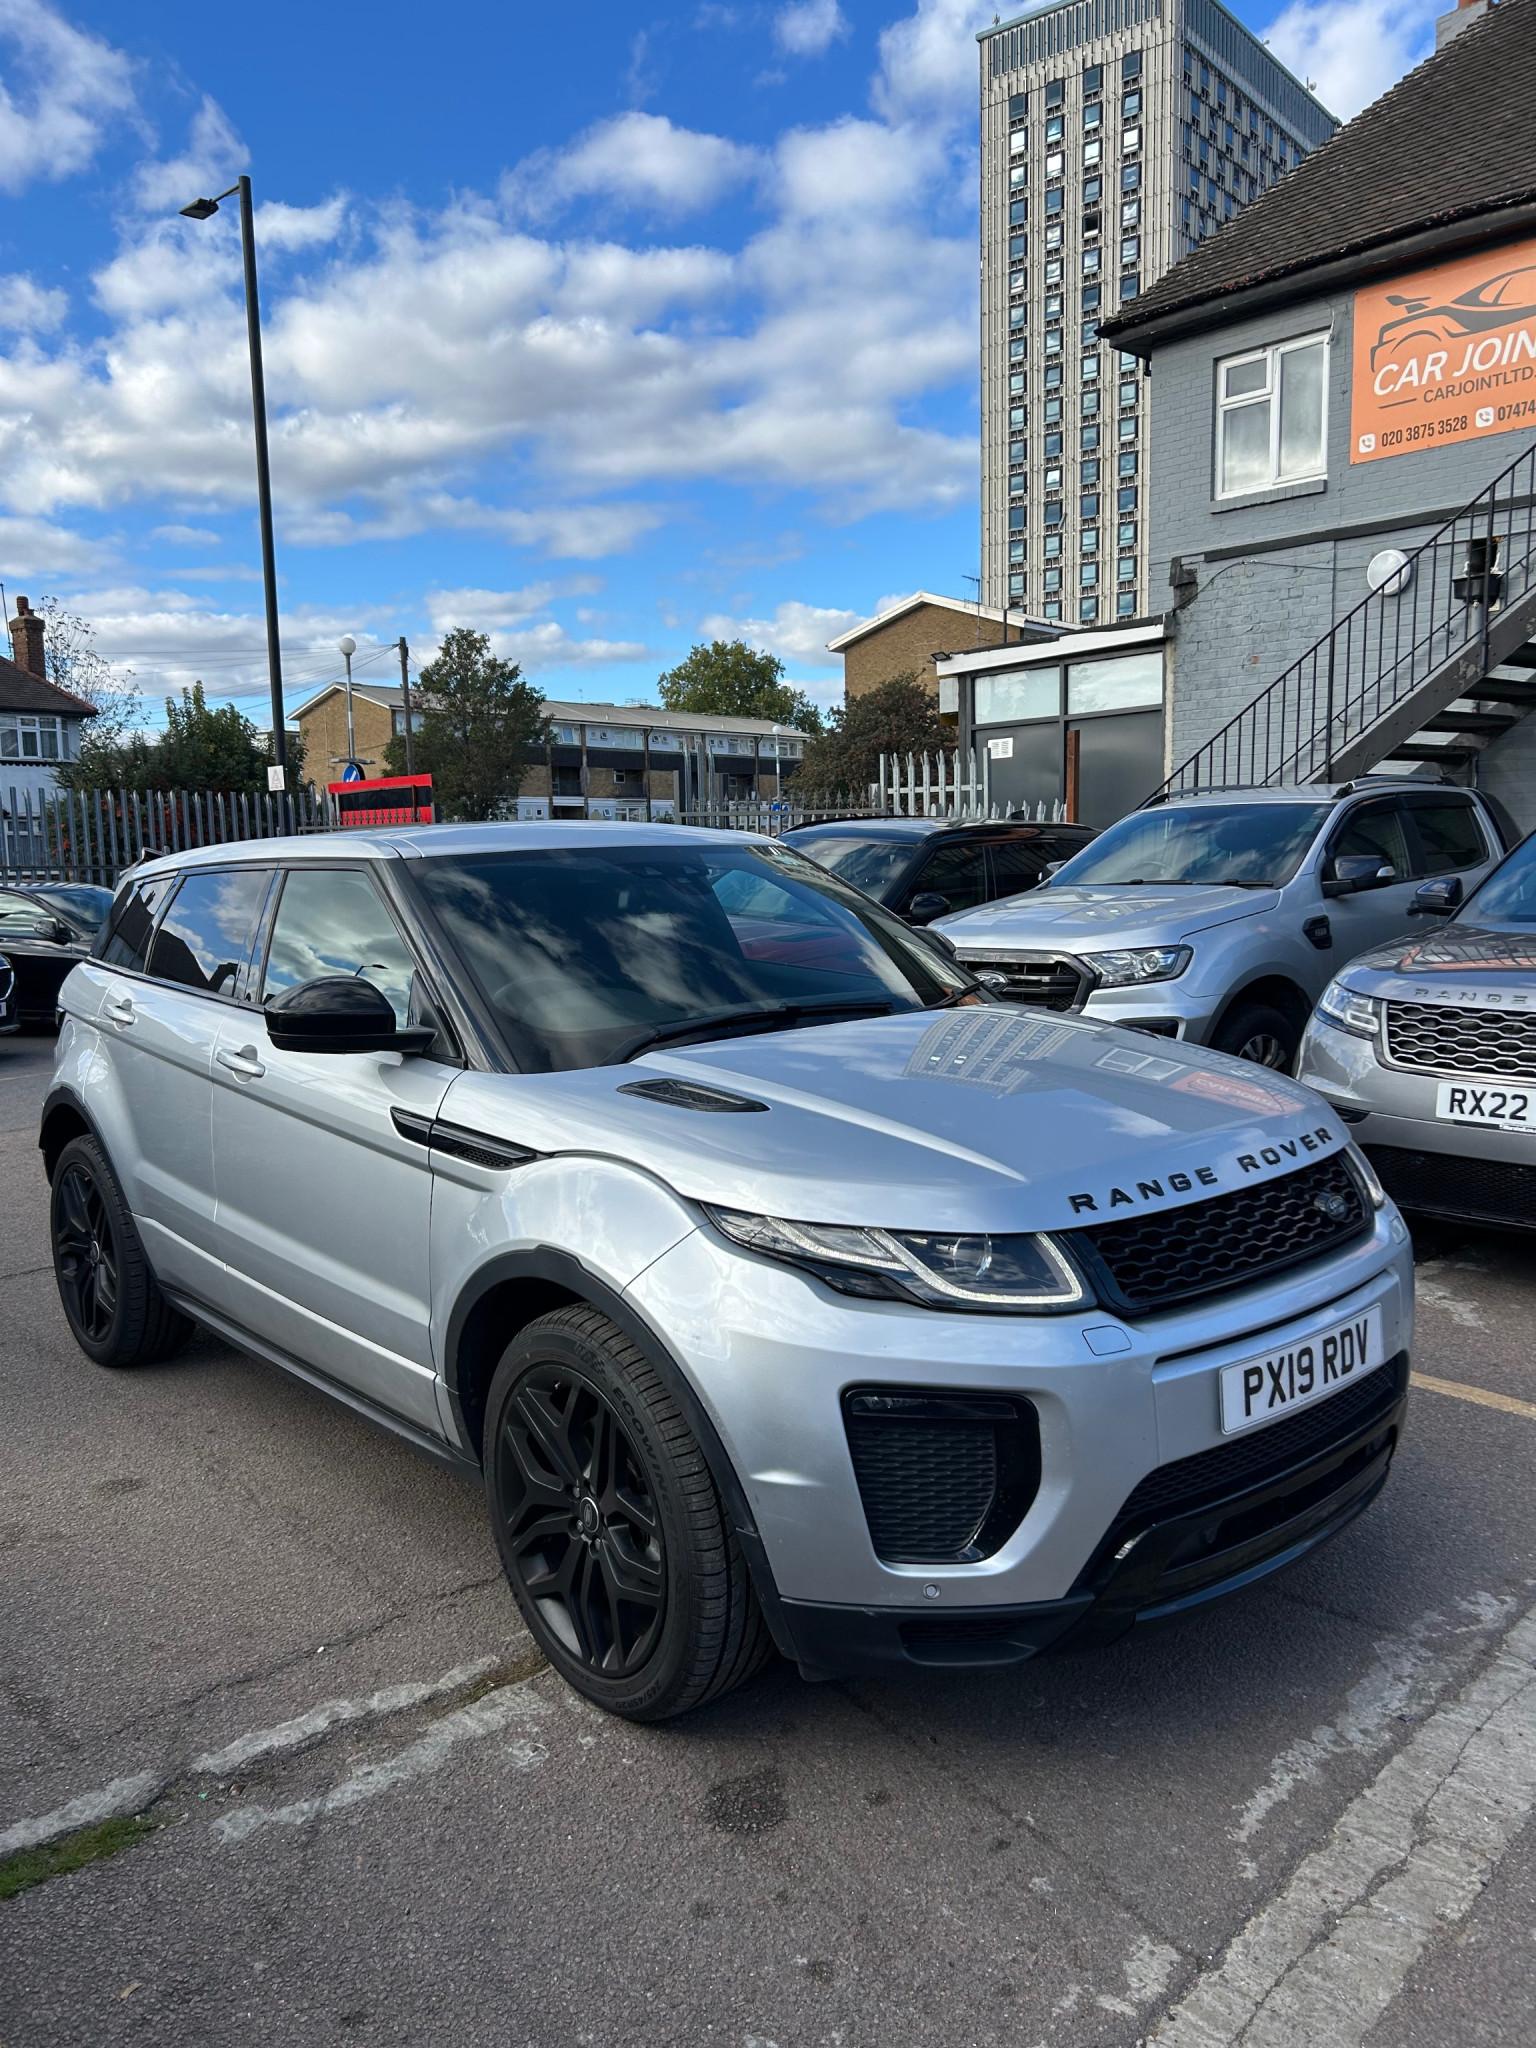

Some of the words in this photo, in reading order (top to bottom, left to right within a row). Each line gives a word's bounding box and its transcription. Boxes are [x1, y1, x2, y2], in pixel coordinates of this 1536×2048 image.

[1373, 350, 1449, 396] CAR
[1452, 329, 1536, 377] JOIN
[1381, 430, 1403, 447] 020
[1406, 422, 1435, 442] 3875
[1438, 415, 1469, 435] 3528
[1497, 399, 1536, 422] 07474
[1414, 987, 1529, 1005] RANGE
[1449, 1087, 1528, 1121] RX22
[1068, 1166, 1218, 1213] RANGE
[1236, 1126, 1333, 1174] ROVER
[1243, 1346, 1314, 1417] PX19
[1322, 1318, 1368, 1385] RDV
[612, 1386, 673, 1514] ECOWING
